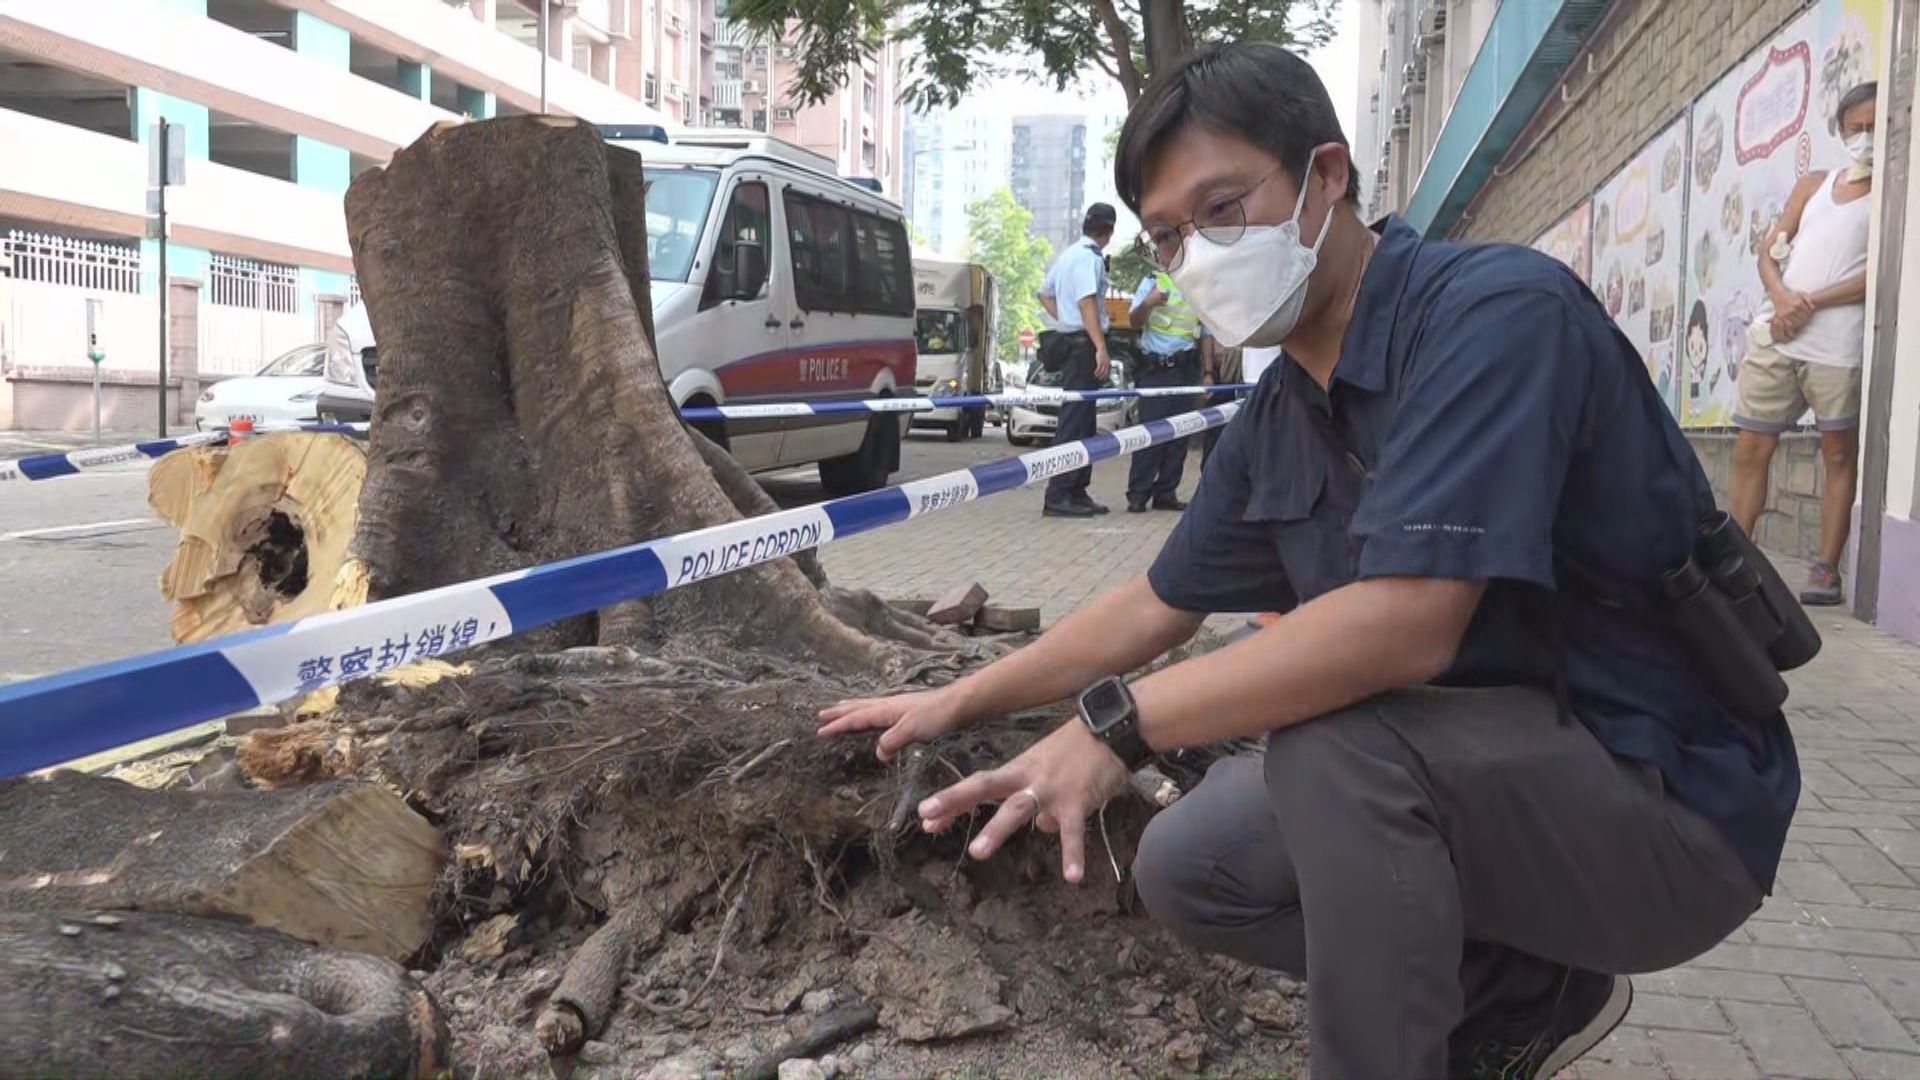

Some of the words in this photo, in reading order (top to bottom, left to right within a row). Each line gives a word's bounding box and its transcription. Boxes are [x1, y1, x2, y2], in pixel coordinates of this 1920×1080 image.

[809, 358, 840, 381] POLICE
[1031, 457, 1056, 478] POLICE
[677, 540, 750, 585] POLICE
[751, 520, 821, 563] CORDON
